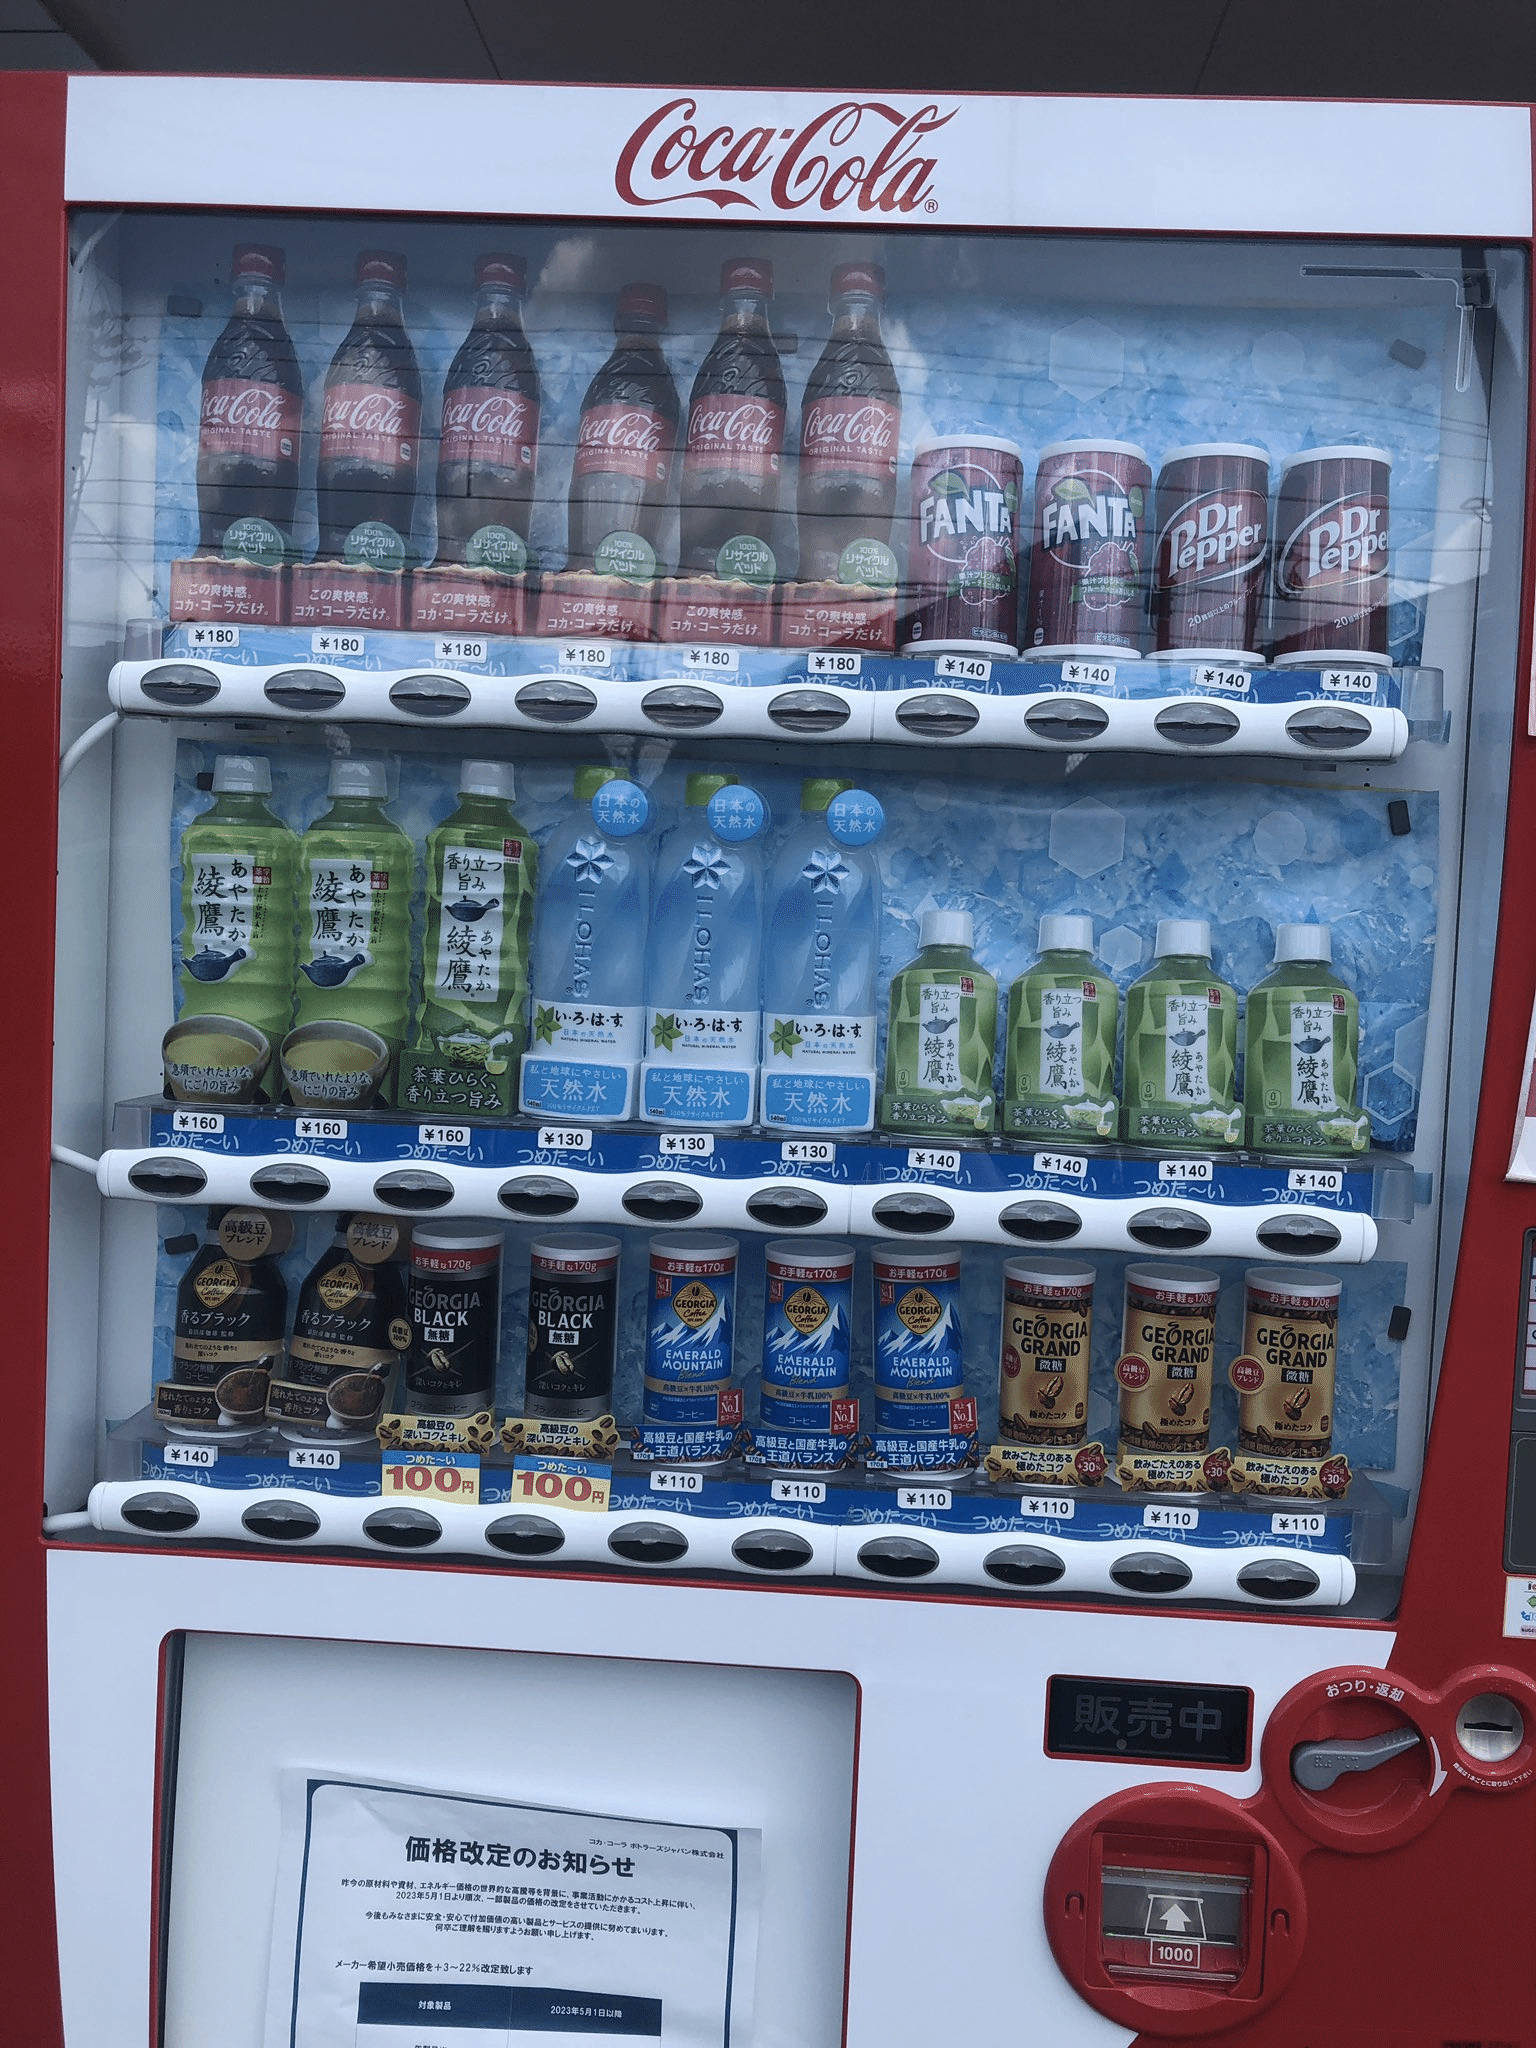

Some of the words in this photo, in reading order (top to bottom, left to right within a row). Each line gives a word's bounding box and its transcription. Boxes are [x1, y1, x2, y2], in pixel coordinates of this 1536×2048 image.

[615, 98, 962, 212] Coca-Cola
[688, 404, 776, 444] Coca-Cola
[804, 406, 894, 448] Coca-Cola
[809, 446, 852, 455] ORIGINAL
[920, 490, 1011, 542] FANTA
[1043, 495, 1135, 549] FANTA
[1198, 503, 1242, 540] Dr
[1341, 506, 1380, 542] Dr
[1168, 519, 1262, 578] Pepper
[1308, 520, 1389, 578] Peppe
[188, 584, 251, 598] この爽快感。
[310, 588, 374, 603] この爽快感。
[175, 600, 269, 616] コカ・コーラだけ。
[295, 605, 391, 620] コカ・コーラだけ。
[417, 609, 512, 624] コカ・コーラだけ。
[195, 629, 233, 643] ¥180
[320, 638, 359, 651] ¥180
[443, 643, 481, 657] ¥180
[565, 649, 605, 663] ¥180
[945, 659, 984, 676] ¥140
[1069, 665, 1109, 682] ¥140
[1204, 669, 1244, 688] ¥140
[1330, 674, 1371, 689] ¥140
[598, 793, 640, 809] 日本の
[714, 798, 755, 814] 日本の
[597, 810, 640, 825] 天然水
[834, 803, 875, 819] 日本の
[714, 814, 756, 829] 天然水
[834, 819, 876, 833] 天然水
[446, 852, 502, 872] 香り立つ
[458, 872, 486, 891] 旨み
[194, 866, 225, 935] 綾鷹
[228, 860, 248, 940] あやたか
[313, 871, 343, 941] 綾鷹
[346, 864, 365, 946] あやたか
[441, 925, 476, 991] 綾鷹
[922, 987, 960, 1000] 香り立つ
[1043, 993, 1082, 1005] 香り立つ
[931, 1001, 949, 1014] 旨み
[1052, 1007, 1071, 1018] 旨み
[1168, 1000, 1207, 1012] 香り立つ
[924, 1038, 945, 1083] 綾鷹
[1045, 1043, 1067, 1089] 綾鷹
[172, 1064, 252, 1079] 急須でいれたような、
[290, 1069, 372, 1084] 急須でいれたような、
[413, 1067, 496, 1088] 茶葉ひらく、
[530, 1064, 622, 1080] 私と地球にやさしい
[651, 1072, 743, 1086] 私と地球にやさしい
[184, 1078, 239, 1093] にごりの旨み
[304, 1083, 358, 1098] にごりの旨み
[540, 1078, 607, 1102] 天然水
[773, 1079, 864, 1092] 私と地球にやさしい
[407, 1086, 502, 1108] 香り立つ旨み
[663, 1085, 730, 1108] 天然水
[784, 1091, 851, 1114] 天然水
[179, 1116, 217, 1129] ¥160
[892, 1112, 948, 1125] 香り立つ旨み
[302, 1122, 340, 1135] ¥160
[425, 1129, 464, 1143] ¥160
[544, 1133, 583, 1146] ¥130
[666, 1137, 705, 1151] ¥130
[788, 1145, 827, 1159] ¥130
[225, 1220, 266, 1235] 高級豆
[353, 1223, 392, 1239] 高級豆
[227, 1235, 263, 1245] ブレンド
[353, 1238, 389, 1249] ブレンド
[415, 1257, 471, 1270] お手軽な170g
[667, 1262, 725, 1273] お手軽な170g
[780, 1266, 837, 1280] お手軽な170g
[889, 1268, 947, 1279] お手軽な170g
[676, 1299, 715, 1309] GEORGIA
[181, 1310, 250, 1327] 香るブラック
[301, 1310, 371, 1331] 香るブラック
[414, 1308, 468, 1327] BLACK
[538, 1311, 592, 1329] BLACK
[1012, 1314, 1087, 1340] GEORGIA
[1142, 1322, 1214, 1346] GEORGIA
[428, 1329, 450, 1342] 無糖
[552, 1332, 575, 1344] 無糖
[1257, 1324, 1334, 1350] GEORGIA
[666, 1349, 721, 1360] EMERALD
[1021, 1340, 1080, 1357] GRAND
[1152, 1345, 1209, 1363] GRAND
[662, 1359, 723, 1371] MOUNTAIN
[778, 1355, 834, 1367] EMERALD
[893, 1356, 950, 1368] EMERALD
[1039, 1358, 1062, 1372] 微糖
[1266, 1350, 1327, 1368] GRAND
[775, 1365, 837, 1377] MOUNTAIN
[890, 1366, 953, 1378] MOUNTAIN
[1171, 1365, 1194, 1379] 微糖
[1286, 1370, 1309, 1384] 微糖
[721, 1394, 741, 1416] No.1
[677, 1411, 704, 1419] コーヒー
[834, 1403, 855, 1424] No.1
[953, 1404, 974, 1423] No.1
[417, 1420, 454, 1430] 高級豆の
[540, 1423, 578, 1434] 高級豆の
[403, 1430, 466, 1444] 深いコクとキレ
[526, 1433, 590, 1446] 深いコクとキレ
[643, 1431, 733, 1444] 高級豆と国産牛乳の
[755, 1435, 847, 1450] 高級豆と国産牛乳の
[655, 1443, 722, 1458] 王道バランス
[876, 1439, 968, 1453] 高級豆と国産牛乳の
[767, 1448, 835, 1464] 王道バランス
[888, 1452, 957, 1466] 王道バランス
[1002, 1451, 1073, 1464] 飲みごたえのある
[1017, 1462, 1064, 1473] 極めたコク
[1134, 1460, 1201, 1470] 飲みごたえのある
[1246, 1462, 1318, 1476] 飲みごたえのある
[386, 1466, 474, 1494] 100円
[1148, 1468, 1193, 1480] 極めたコク
[1261, 1474, 1309, 1486] 極めたコク
[657, 1475, 696, 1489] ¥110
[781, 1484, 820, 1498] ¥110
[907, 1493, 946, 1506] ¥110
[1029, 1501, 1069, 1516] ¥110
[1326, 1680, 1405, 1702] おつり・返却
[1073, 1694, 1222, 1742] 販売中
[589, 1838, 627, 1848] コカ・コーラ
[630, 1843, 724, 1859] ボトラーズジャパン株式会社
[405, 1836, 635, 1879] 価格改定のお知らせ
[396, 1891, 642, 1915] 2023年5月1日より順次、一部製品の価格の改定をさせていただきます。
[1157, 1946, 1193, 1963] 1000
[418, 2000, 452, 2011] 対象製品
[550, 2005, 623, 2019] 2023年5月1日以降
